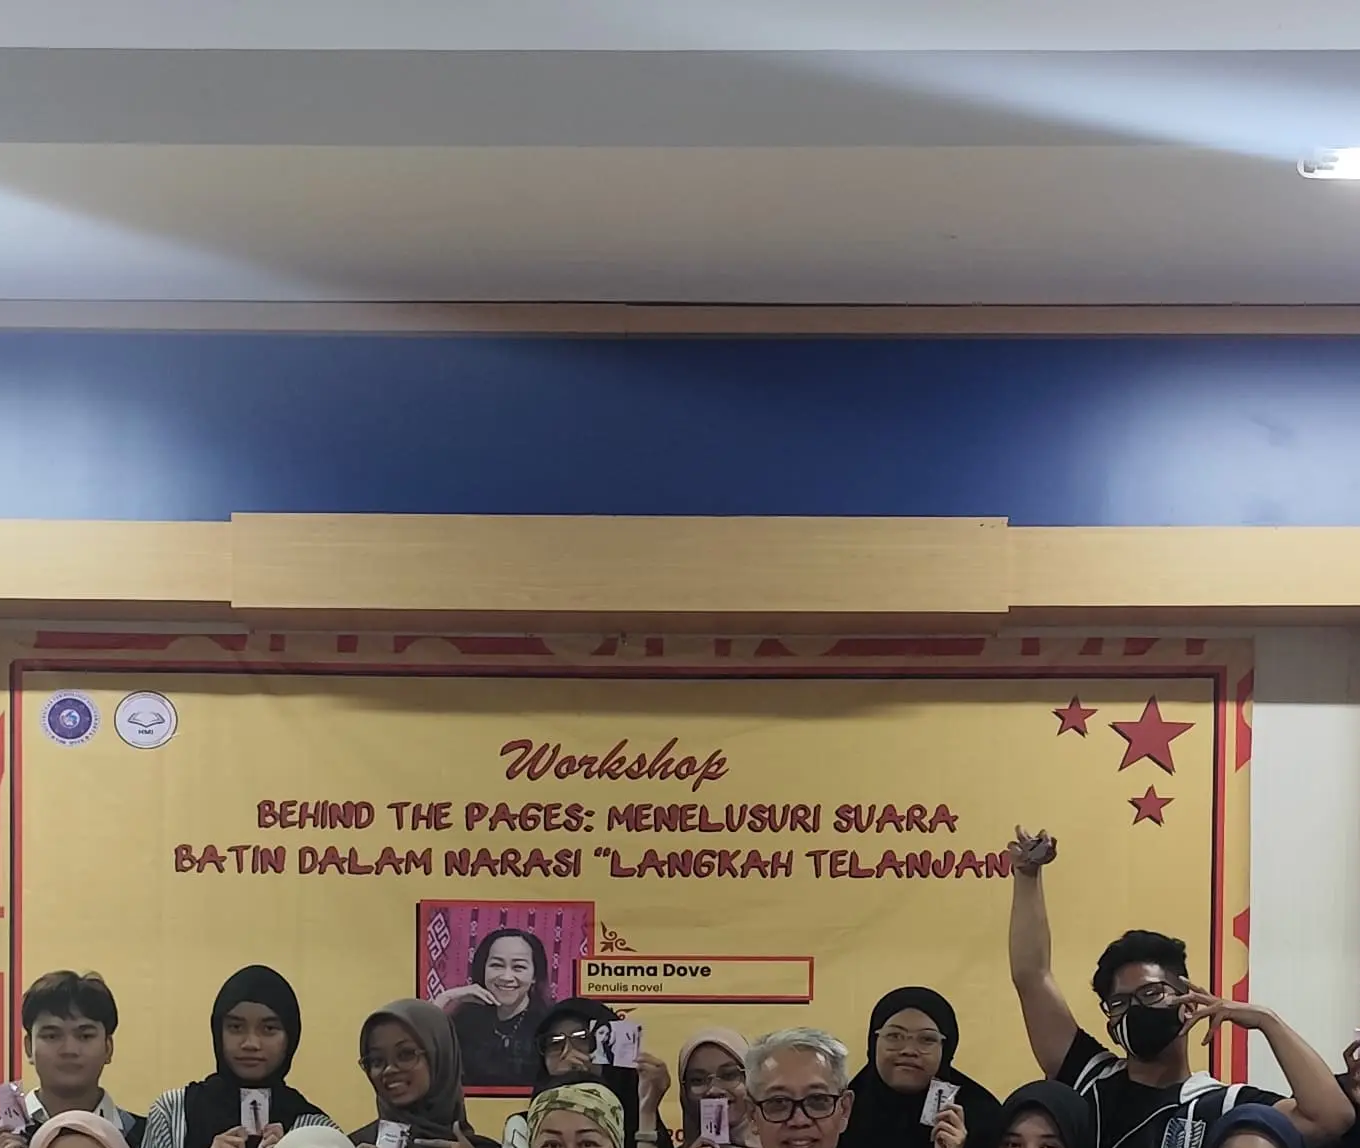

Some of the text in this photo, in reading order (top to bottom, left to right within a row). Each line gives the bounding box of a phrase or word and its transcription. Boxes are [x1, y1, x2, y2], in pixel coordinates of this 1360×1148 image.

[500, 737, 731, 792] Workshop
[257, 800, 959, 833] BEHIND THE PAGES: MENELUSURI SUARA
[174, 844, 1014, 879] BATIN DALAM NARASI "LANGKAH TELANJAN
[587, 963, 712, 977] Dhama Dove
[587, 982, 663, 992] Penulis novel
